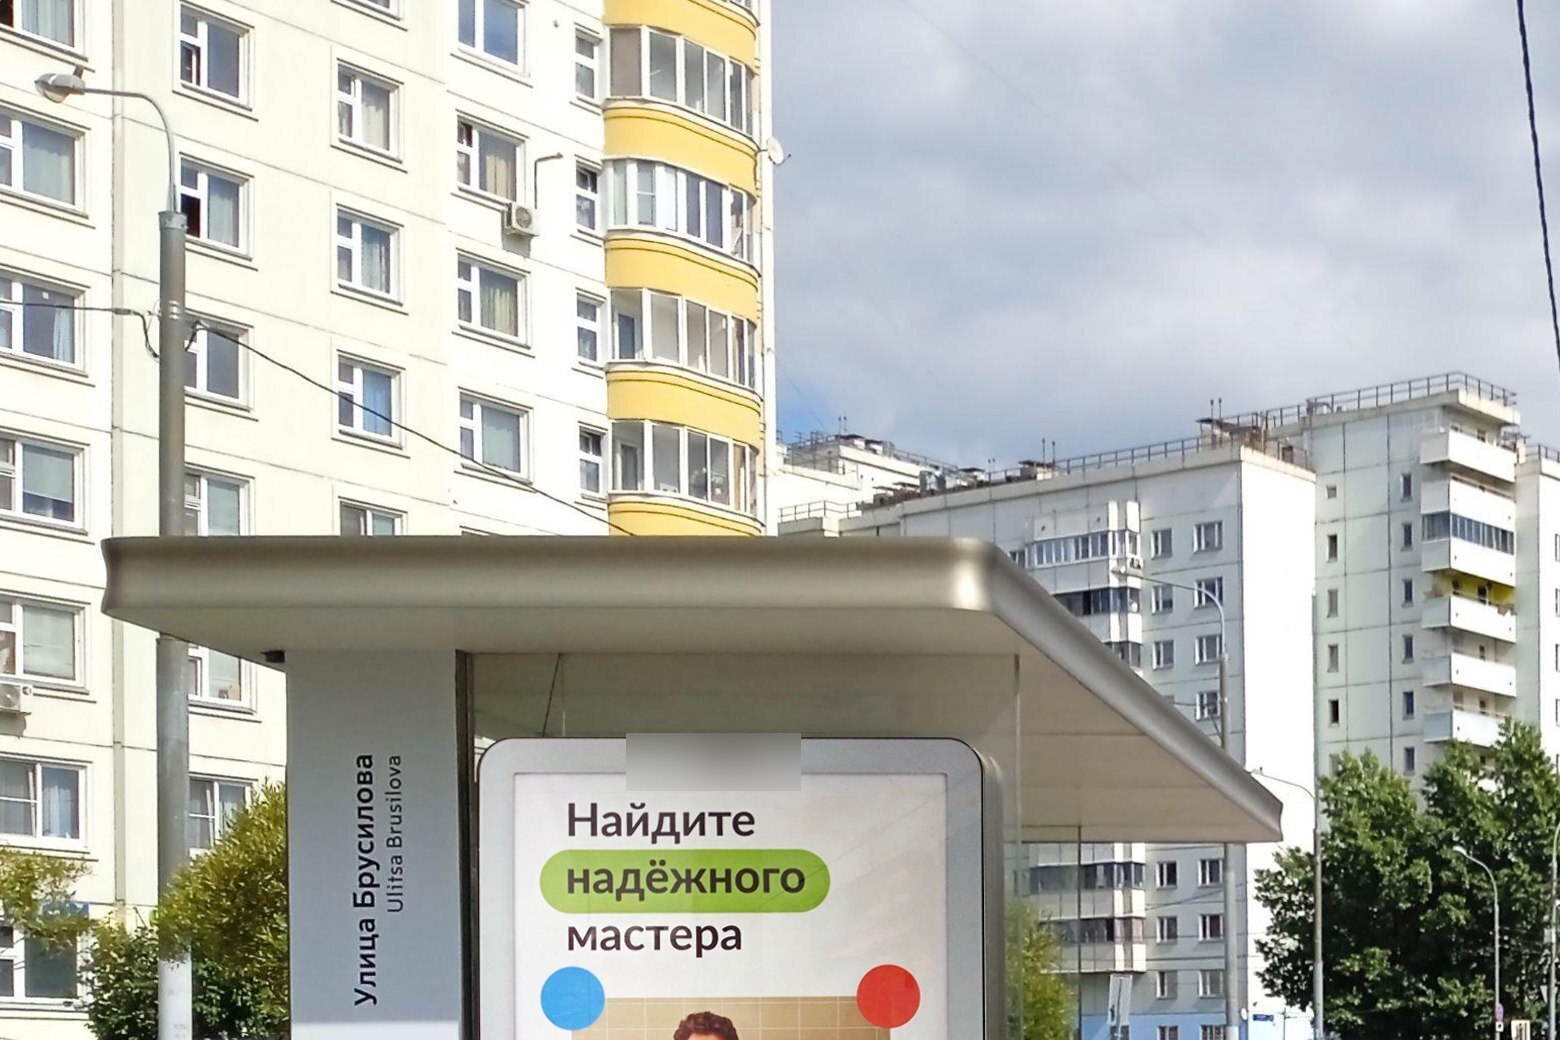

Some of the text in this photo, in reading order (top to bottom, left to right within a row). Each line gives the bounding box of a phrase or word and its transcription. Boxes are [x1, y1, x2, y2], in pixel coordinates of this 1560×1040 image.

[384, 755, 403, 912] Ulitsa Brusilova
[568, 802, 755, 844] Найдите
[353, 754, 380, 1005] Улица Брусилова
[567, 859, 806, 902] надёжного
[568, 924, 742, 958] мастера
